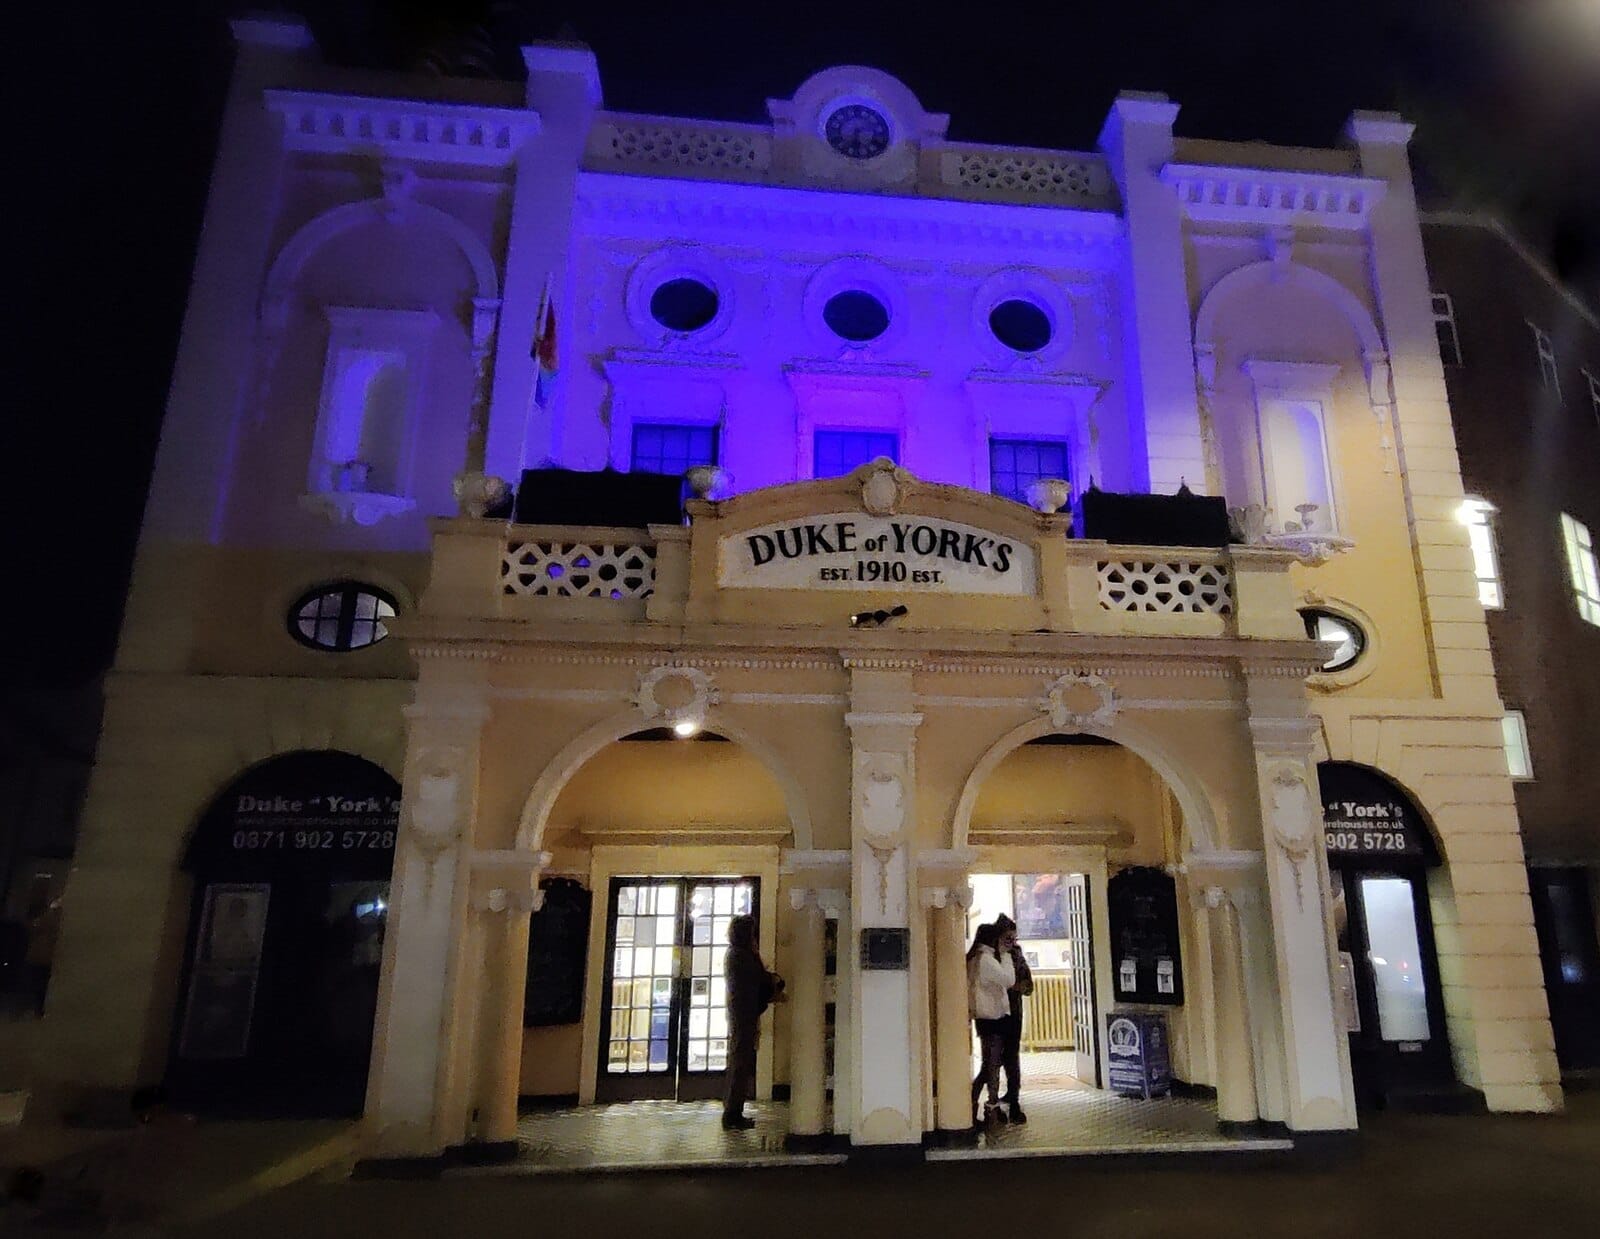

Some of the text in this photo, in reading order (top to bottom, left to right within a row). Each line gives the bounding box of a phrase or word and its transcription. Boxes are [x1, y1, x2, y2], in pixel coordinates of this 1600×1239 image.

[748, 522, 1013, 573] DUKE of YORK'S
[821, 561, 944, 584] EST. 1910 EST.
[237, 795, 303, 813] Duke
[327, 795, 400, 813] York's
[1342, 802, 1403, 818] York's
[1325, 820, 1405, 831] rehouses.co.uk
[232, 831, 394, 848] 0871 902 5728
[1327, 833, 1405, 850] 902 5728
